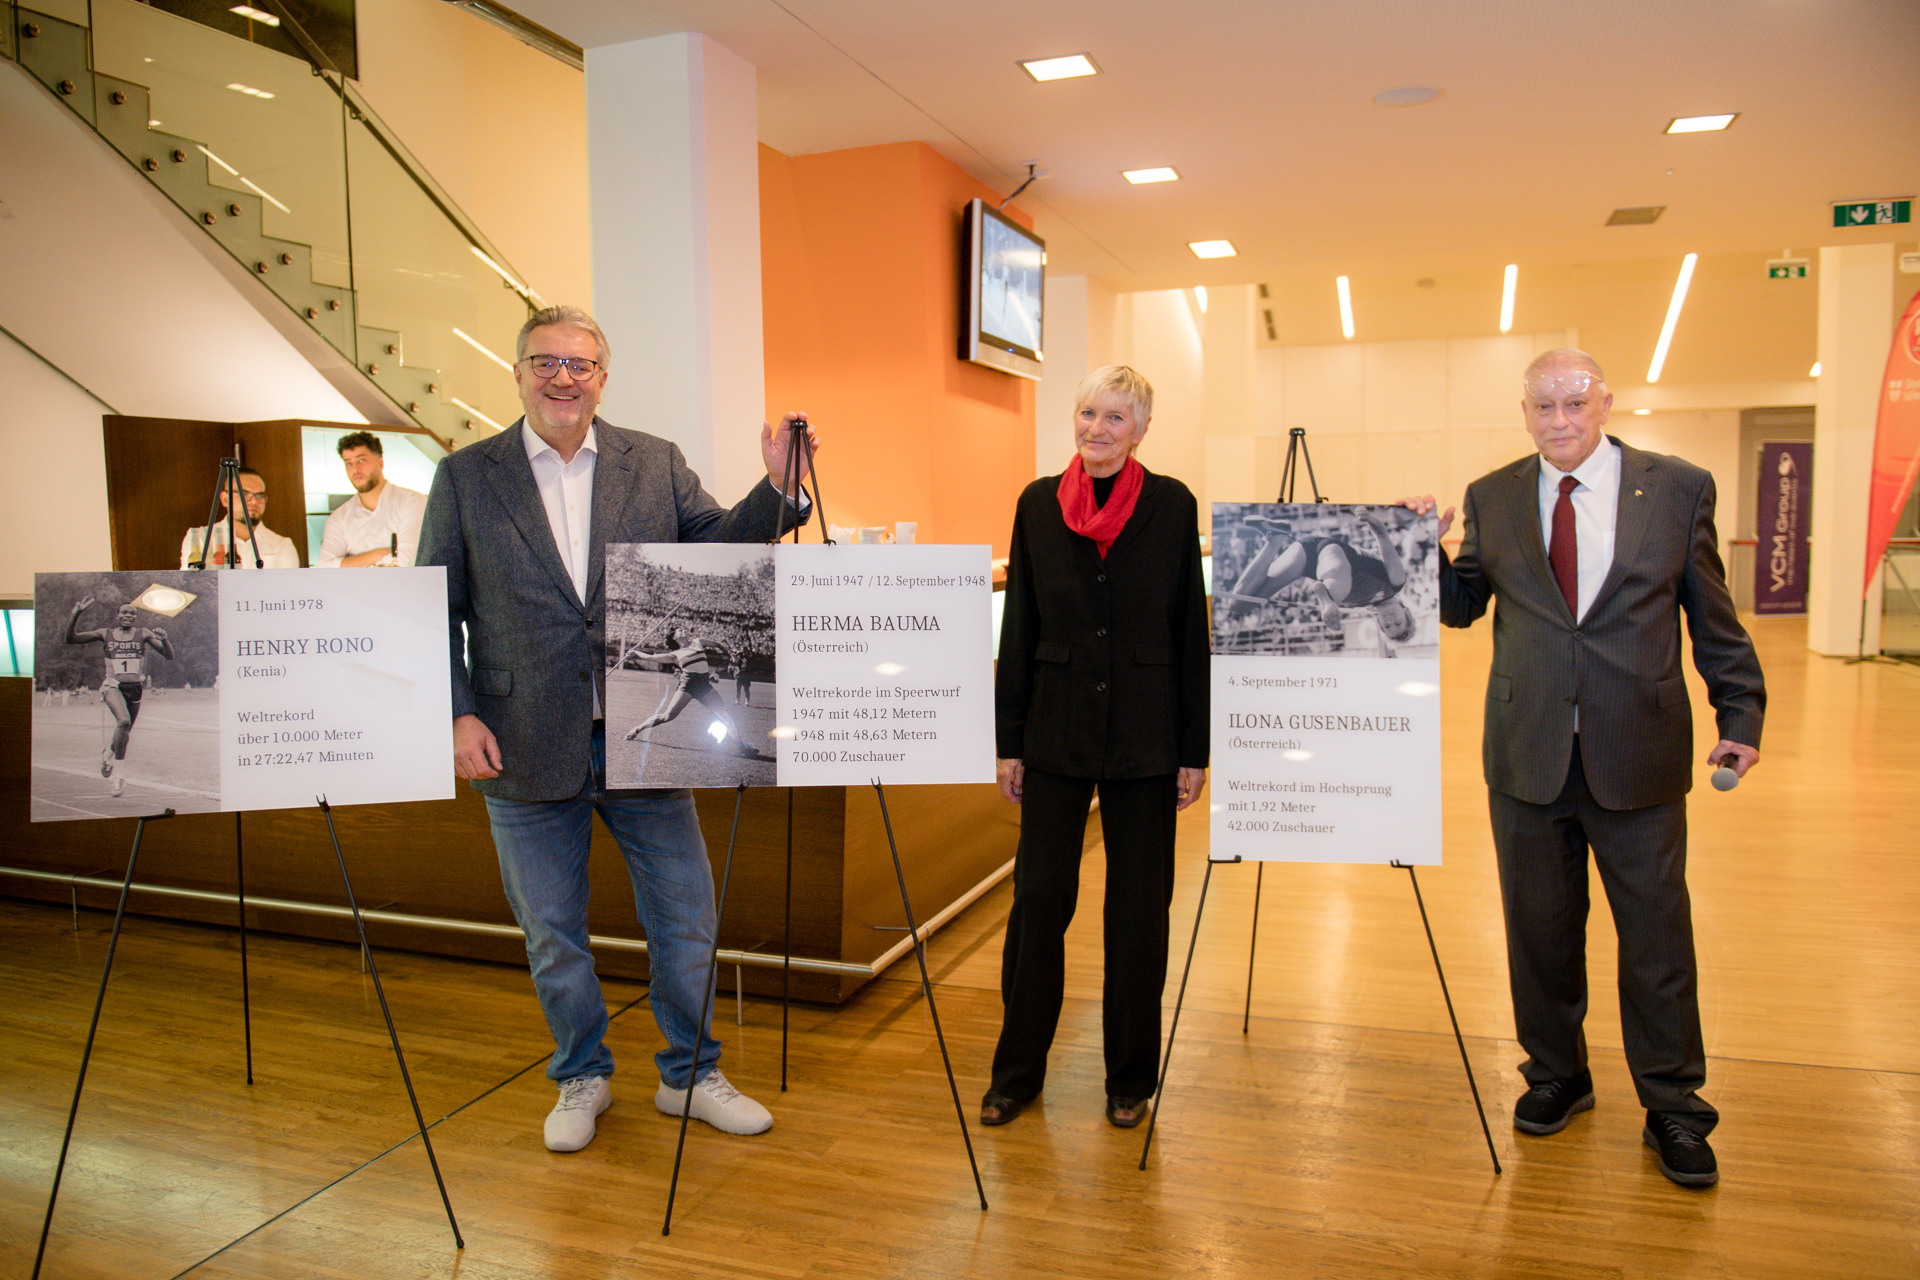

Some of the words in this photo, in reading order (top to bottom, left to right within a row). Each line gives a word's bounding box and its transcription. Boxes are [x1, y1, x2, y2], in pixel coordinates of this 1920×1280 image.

[1775, 477, 1791, 533] Group
[1769, 536, 1788, 593] VCM
[790, 574, 809, 586] 29.
[810, 574, 833, 589] Juni
[835, 574, 864, 587] 1947
[867, 575, 874, 588] /
[876, 574, 894, 587] 12.
[895, 574, 956, 590] September
[958, 575, 986, 587] 1948
[235, 600, 257, 612] 11.
[259, 599, 287, 614] Juni
[290, 598, 324, 611] 1978
[791, 615, 865, 632] HERMA
[869, 615, 942, 632] BAUMA
[108, 641, 141, 651] SPORTS
[236, 638, 310, 657] HENRY
[315, 636, 374, 654] RONO
[792, 639, 869, 655] (Österreich)
[121, 661, 128, 673] 1
[237, 665, 287, 679] (Kenia)
[1228, 675, 1239, 686] 4.
[1241, 675, 1307, 690] September
[1310, 677, 1338, 688] 1971
[791, 686, 872, 699] Weltrekorde
[875, 686, 892, 698] im
[894, 685, 962, 701] Speerwurf
[236, 708, 315, 723] Weltrekord
[792, 708, 825, 720] 1947
[828, 708, 850, 720] mit
[852, 707, 888, 721] 48,12
[891, 707, 937, 719] Metern
[1228, 713, 1284, 730] ILONA
[1288, 714, 1412, 732] GUSENBAUER
[237, 732, 270, 745] über
[272, 730, 320, 744] 10.000
[323, 729, 364, 741] Meter
[792, 729, 825, 742] 1948
[828, 729, 850, 741] mit
[852, 728, 888, 742] 48,63
[892, 728, 938, 741] Metern
[1228, 735, 1301, 750] (Österreich)
[237, 755, 252, 767] in
[254, 751, 314, 766] 27:22,47
[318, 750, 375, 763] Minuten
[792, 750, 837, 763] 70.000
[839, 750, 906, 763] Zuschauer
[1227, 780, 1297, 793] Weltrekord
[1300, 782, 1316, 793] im
[1319, 782, 1392, 798] Hochsprung
[1228, 800, 1248, 812] mit
[1251, 800, 1277, 813] 1,92
[1280, 801, 1317, 813] Meter
[1227, 820, 1270, 832] 42.000
[1272, 821, 1336, 834] Zuschauer
